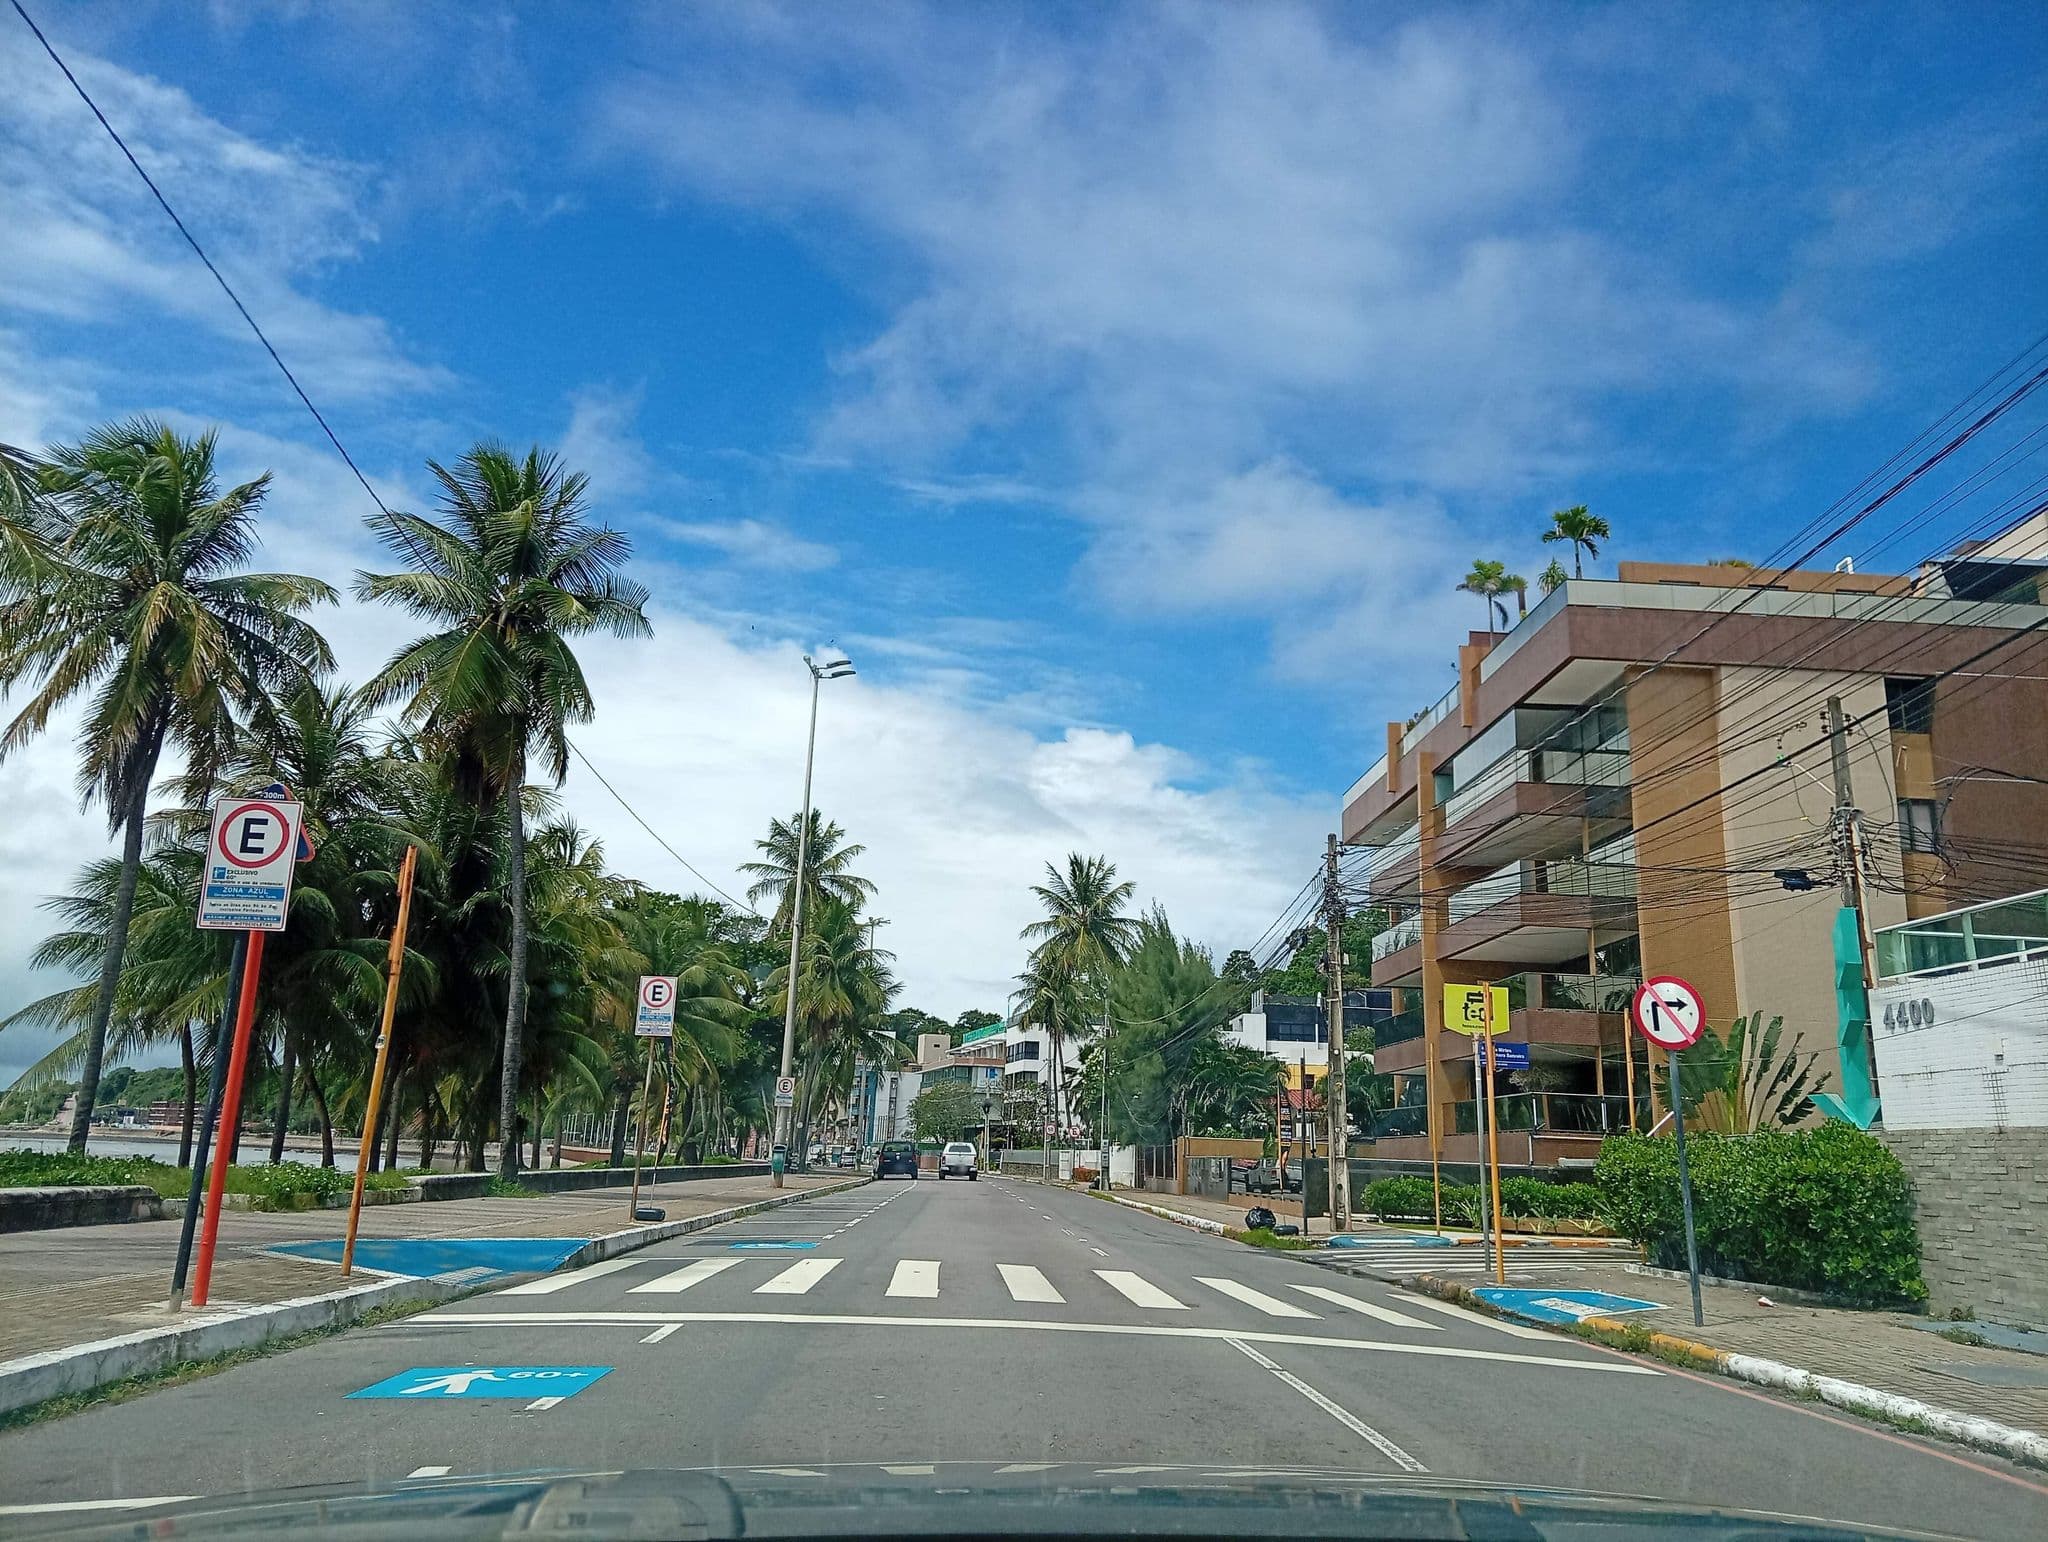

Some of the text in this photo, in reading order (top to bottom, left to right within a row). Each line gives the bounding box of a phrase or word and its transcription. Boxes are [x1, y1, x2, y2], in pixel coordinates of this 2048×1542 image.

[240, 818, 269, 854] E
[248, 887, 269, 895] AZUL
[651, 984, 663, 1001] E
[1883, 998, 1935, 1033] 4400
[508, 1371, 589, 1379] 60+
